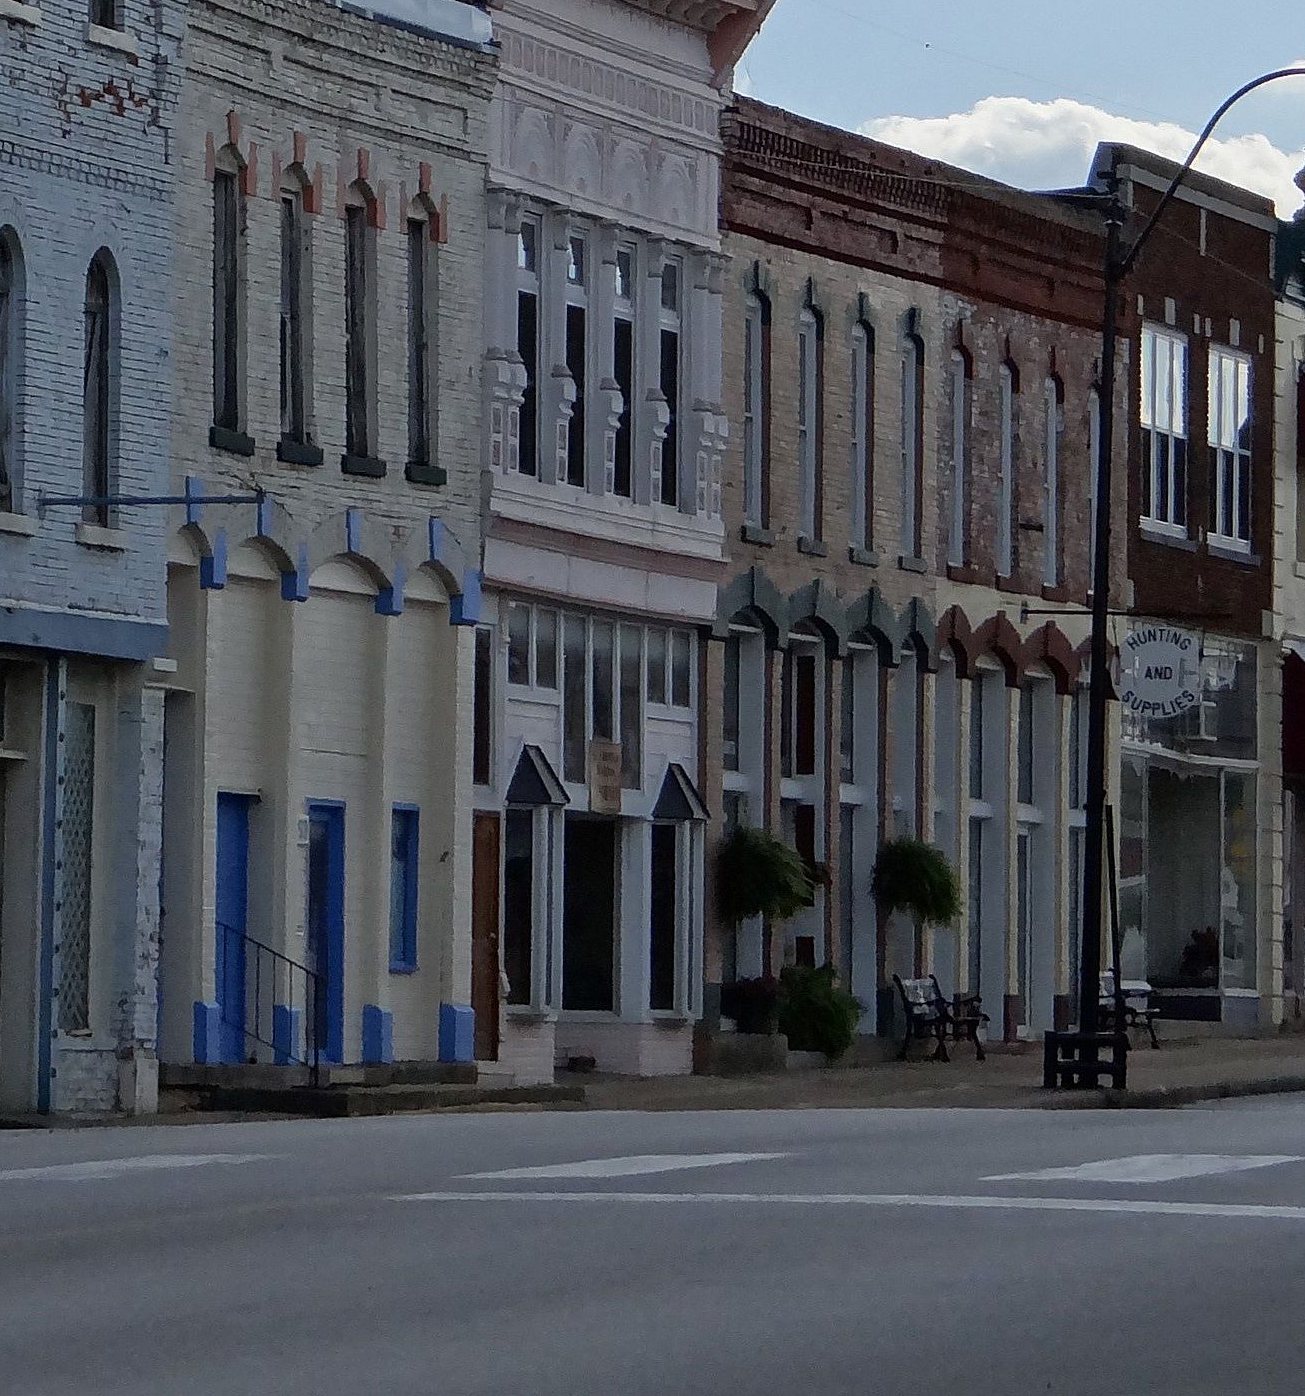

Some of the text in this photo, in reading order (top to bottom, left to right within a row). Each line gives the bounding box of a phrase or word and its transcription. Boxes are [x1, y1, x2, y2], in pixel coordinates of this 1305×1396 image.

[1126, 628, 1191, 651] HUNTING
[1145, 665, 1173, 680] AND
[1122, 690, 1194, 716] SUPPLIES
